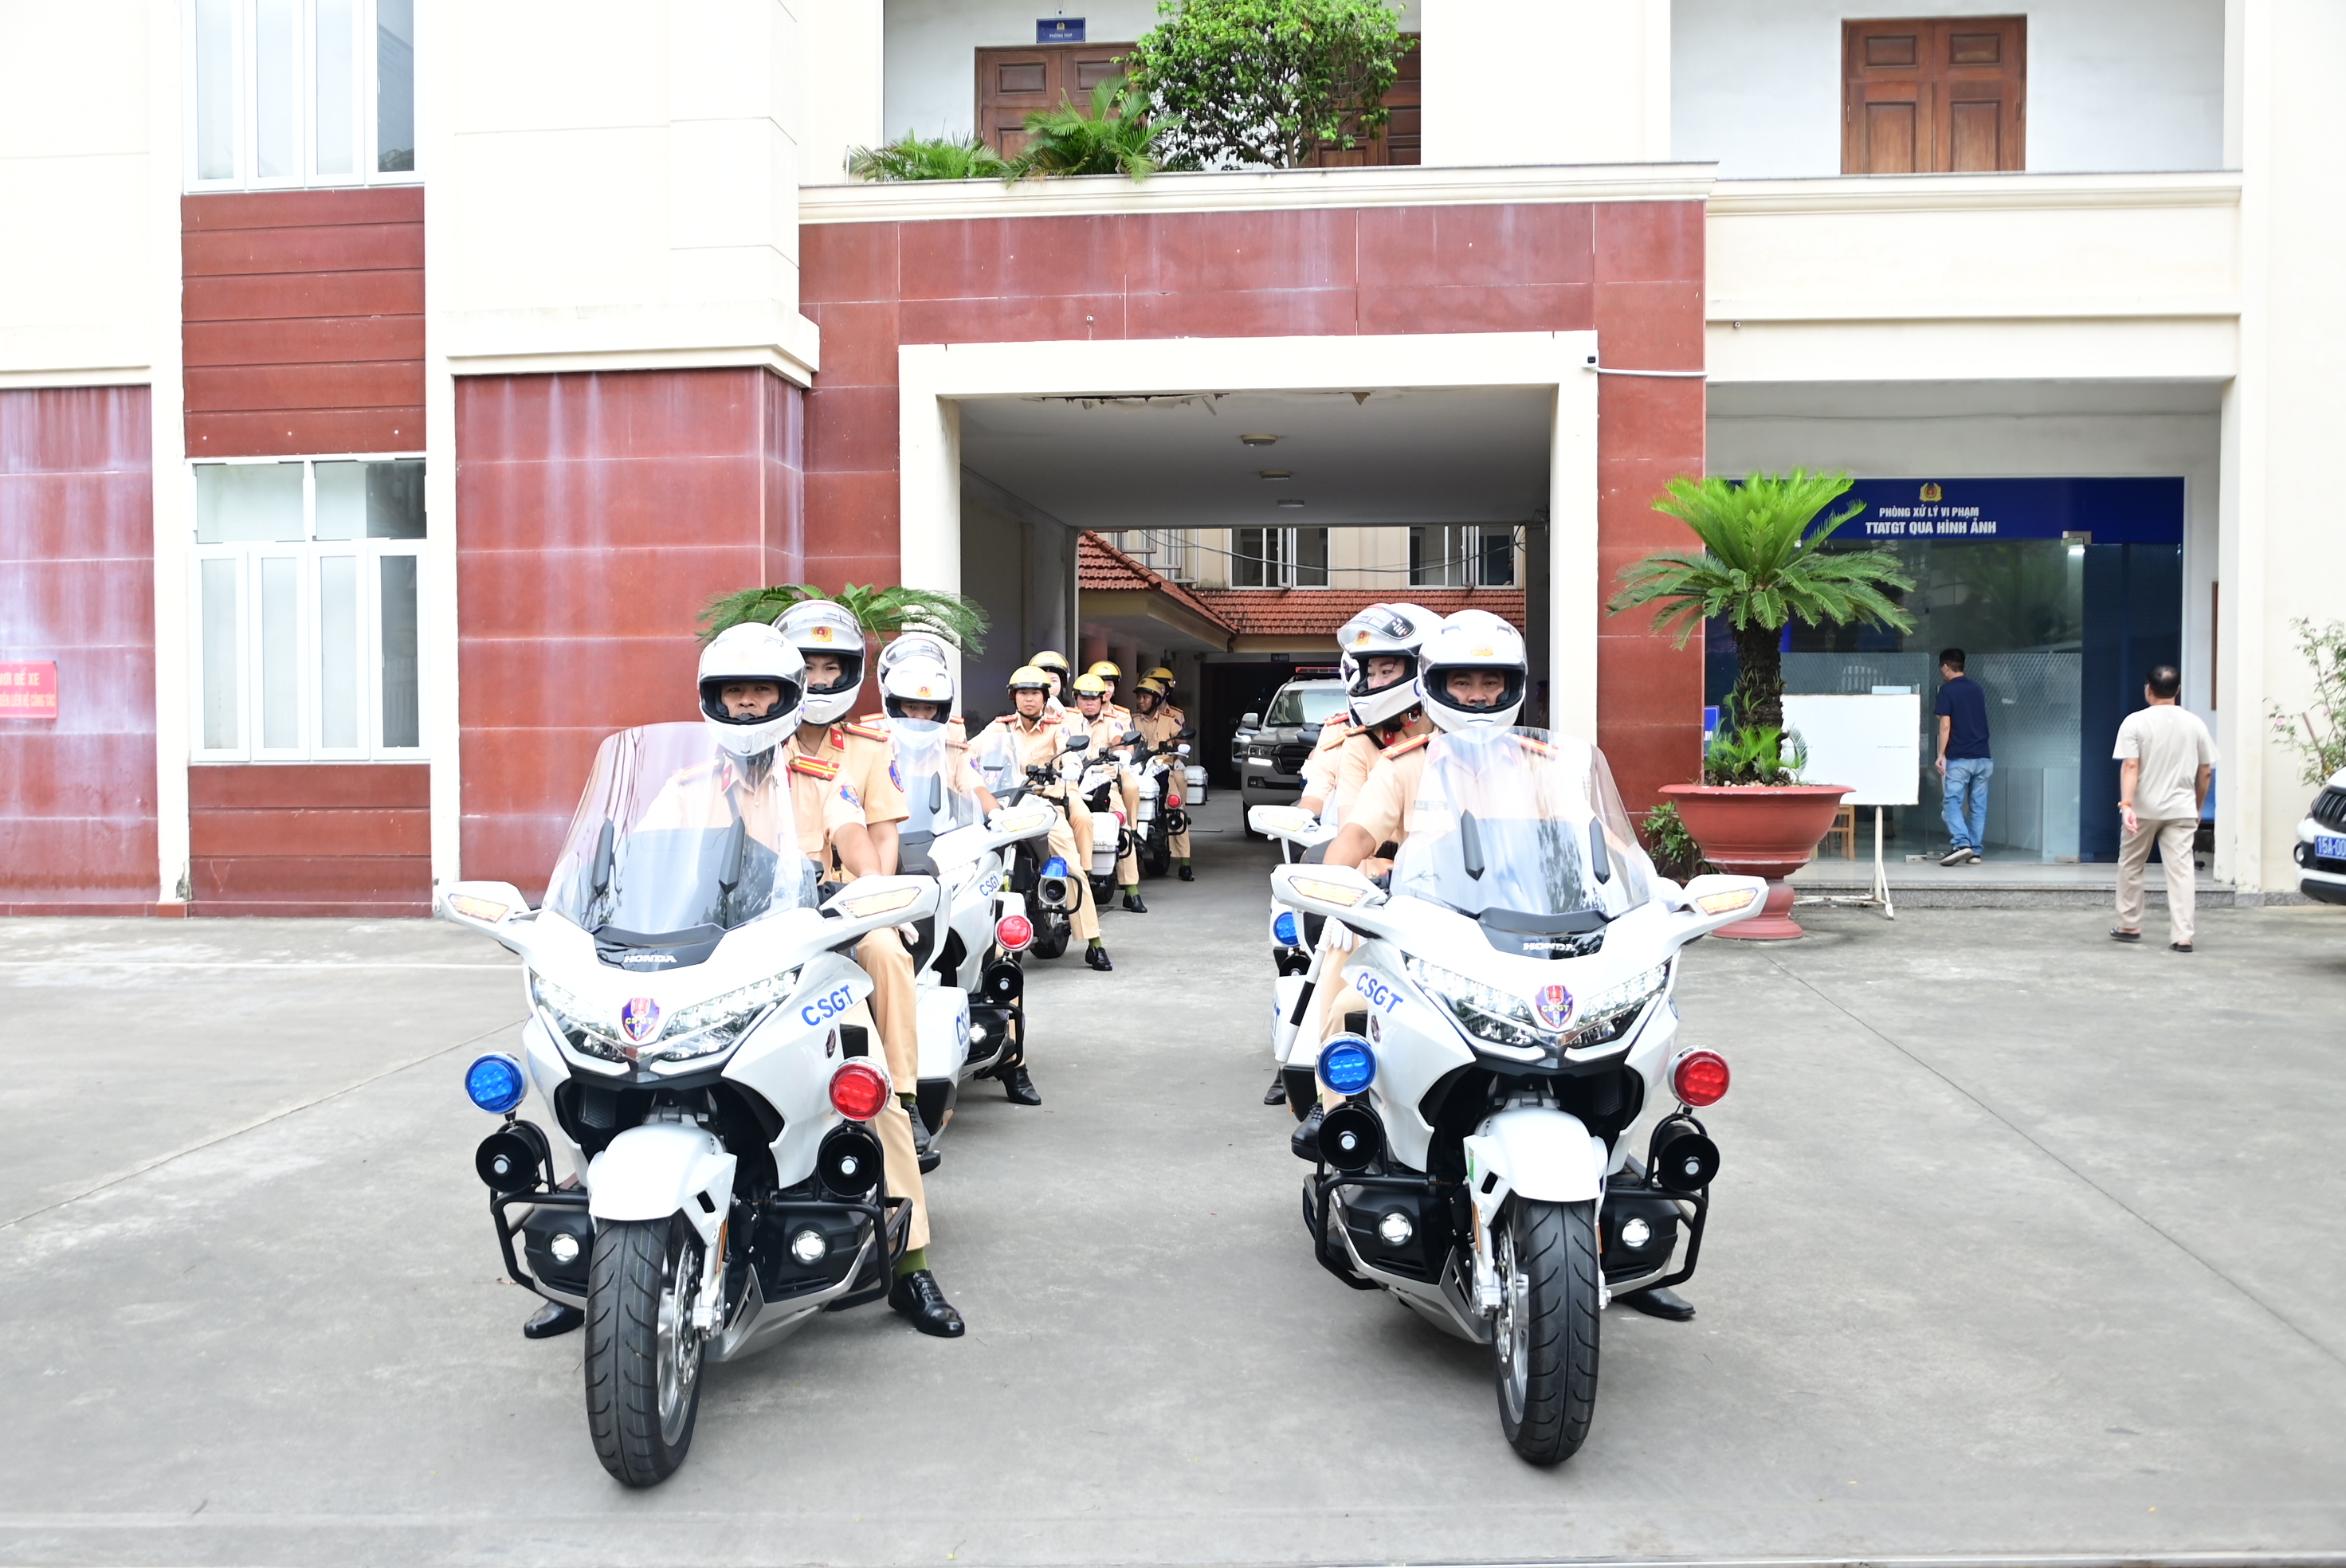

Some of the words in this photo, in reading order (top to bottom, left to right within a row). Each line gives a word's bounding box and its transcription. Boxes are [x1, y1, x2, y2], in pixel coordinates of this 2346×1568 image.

[1879, 505, 1911, 517] PHÒNG
[1912, 504, 1926, 517] XỬ
[1927, 505, 1938, 517] LÝ
[1940, 507, 1950, 517] VI
[1952, 507, 1979, 519] PHẠM
[1865, 522, 1906, 534] TTATGT
[1909, 521, 1934, 535] QUA
[1936, 519, 1967, 534] HÌNH
[1970, 517, 1997, 534] ẢNH
[28, 672, 40, 685] XE
[1523, 943, 1576, 951] HONDA
[623, 955, 677, 963] HONDA
